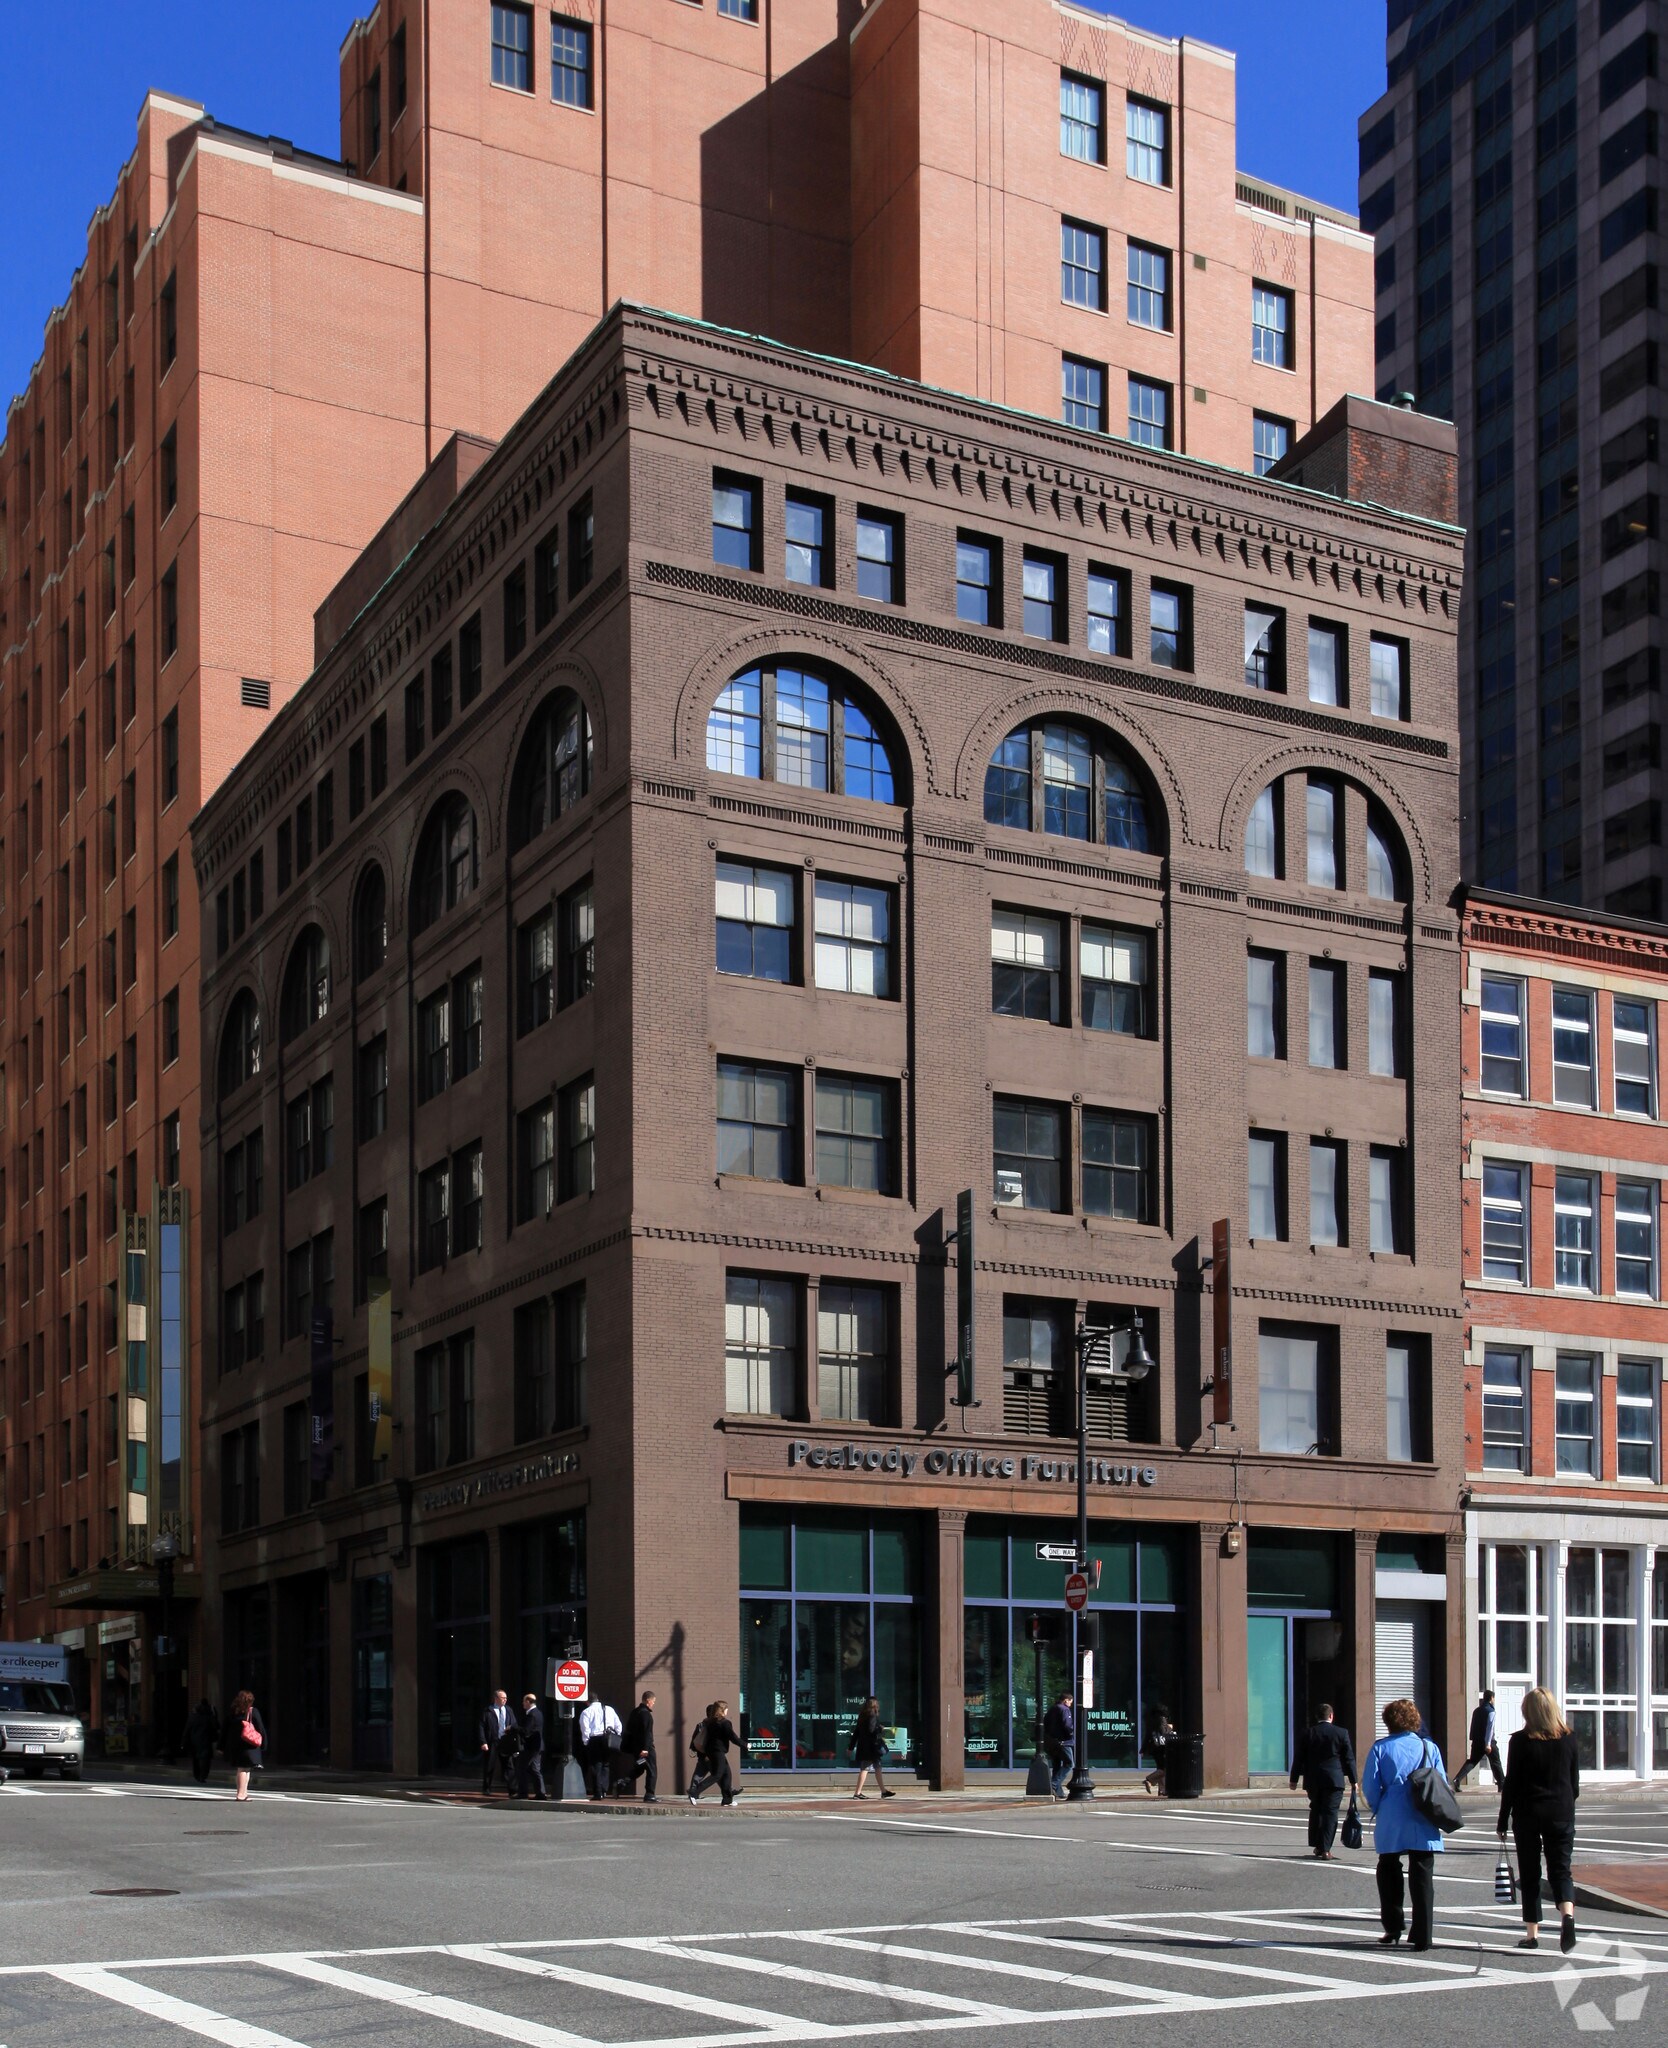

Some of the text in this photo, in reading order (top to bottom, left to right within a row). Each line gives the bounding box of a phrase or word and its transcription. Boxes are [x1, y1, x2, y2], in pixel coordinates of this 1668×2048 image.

[793, 1440, 919, 1475] Peabody
[928, 1448, 1016, 1476] Office
[847, 1697, 866, 1705] twiligh
[1087, 1711, 1100, 1720] you
[1101, 1710, 1119, 1720] build
[1087, 1722, 1096, 1730] he
[1097, 1722, 1110, 1730] will
[747, 1739, 780, 1751] eabody
[968, 1740, 998, 1752] peabody
